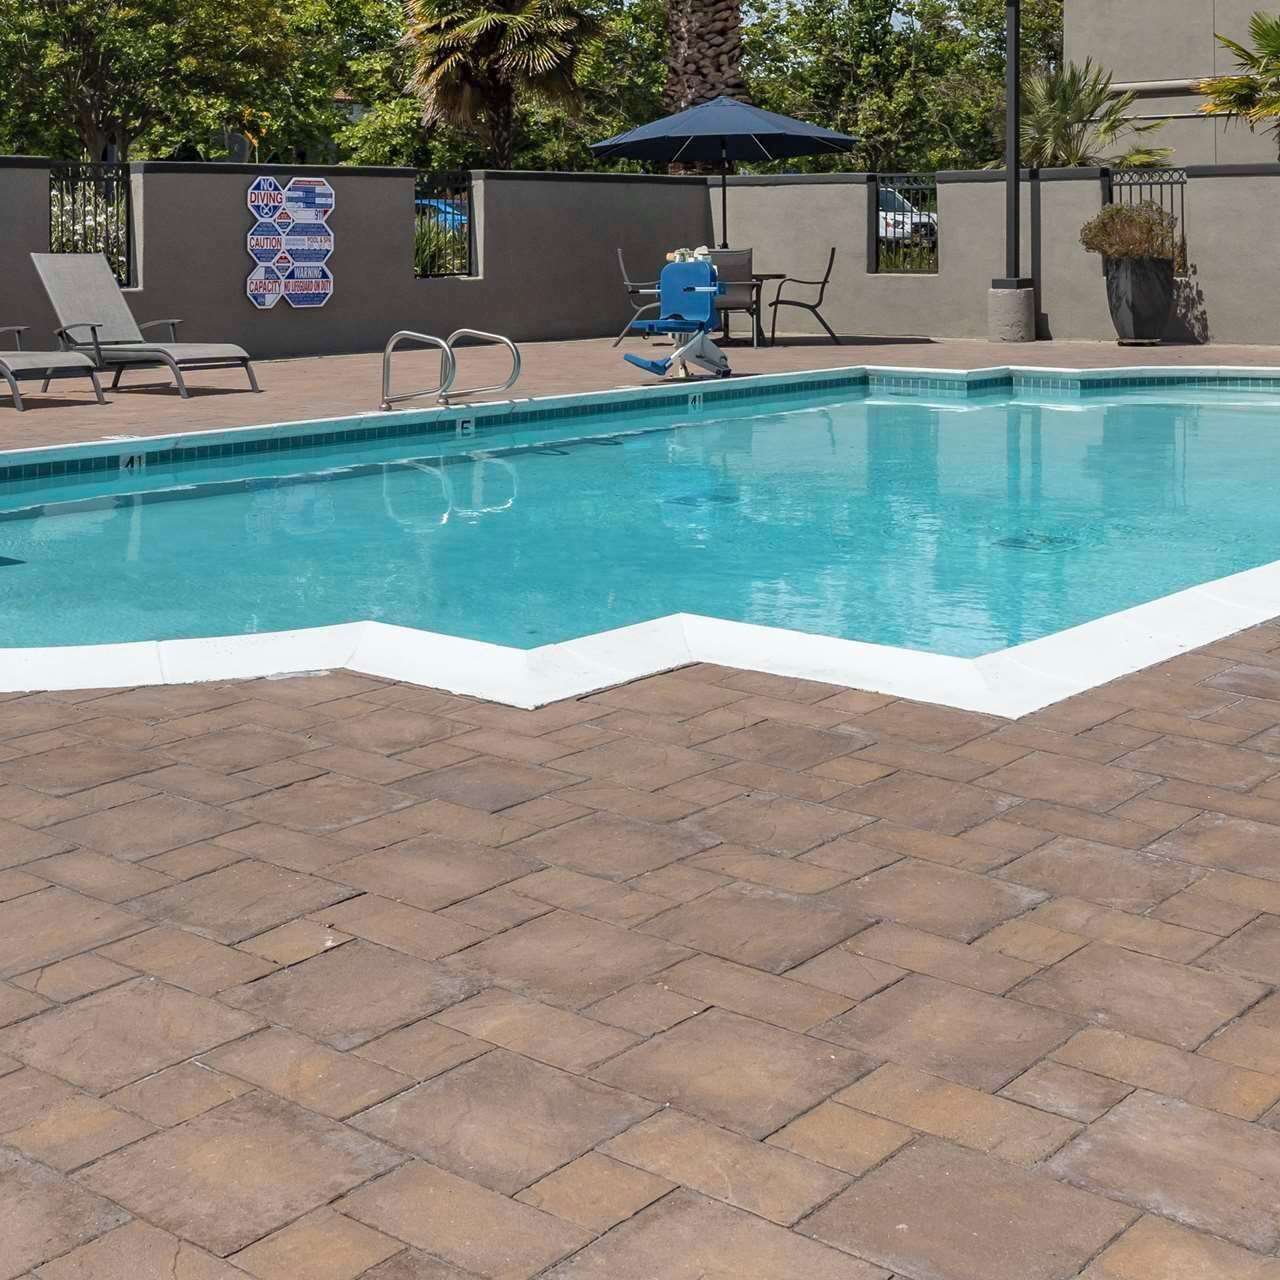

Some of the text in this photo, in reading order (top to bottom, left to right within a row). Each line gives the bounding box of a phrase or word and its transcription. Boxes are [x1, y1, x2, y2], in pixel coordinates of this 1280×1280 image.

[260, 179, 275, 190] NO
[249, 191, 283, 204] DIVING
[249, 237, 283, 249] CAUTION
[294, 267, 322, 278] WARNING
[248, 280, 282, 293] CAPACITY
[284, 280, 331, 292] NO LIFEGUARD ON DUTY
